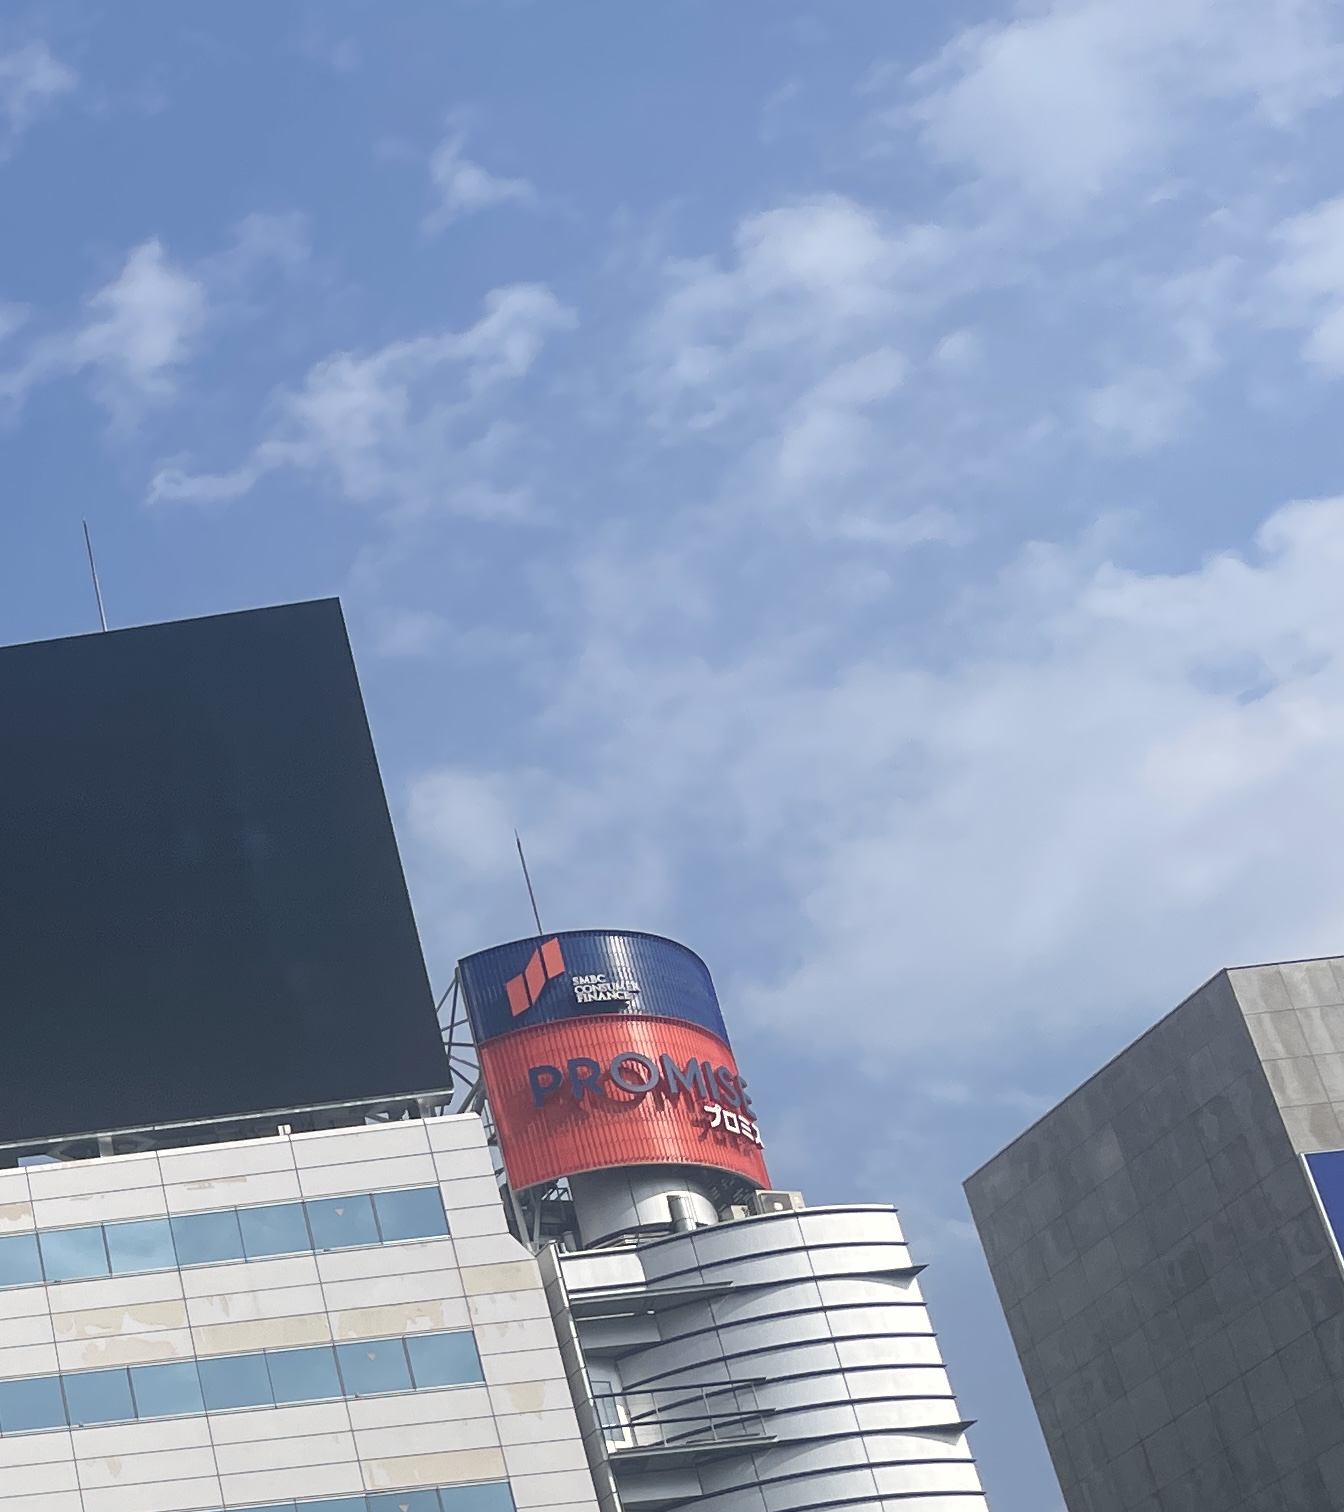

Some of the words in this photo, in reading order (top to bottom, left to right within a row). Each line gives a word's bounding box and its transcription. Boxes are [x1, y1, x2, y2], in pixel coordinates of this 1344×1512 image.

[572, 973, 607, 986] SMBC
[574, 980, 641, 995] CONSUMER
[577, 991, 632, 1003] FINANCE
[528, 1052, 758, 1120] PROMISE
[703, 1103, 765, 1149] プロミス
